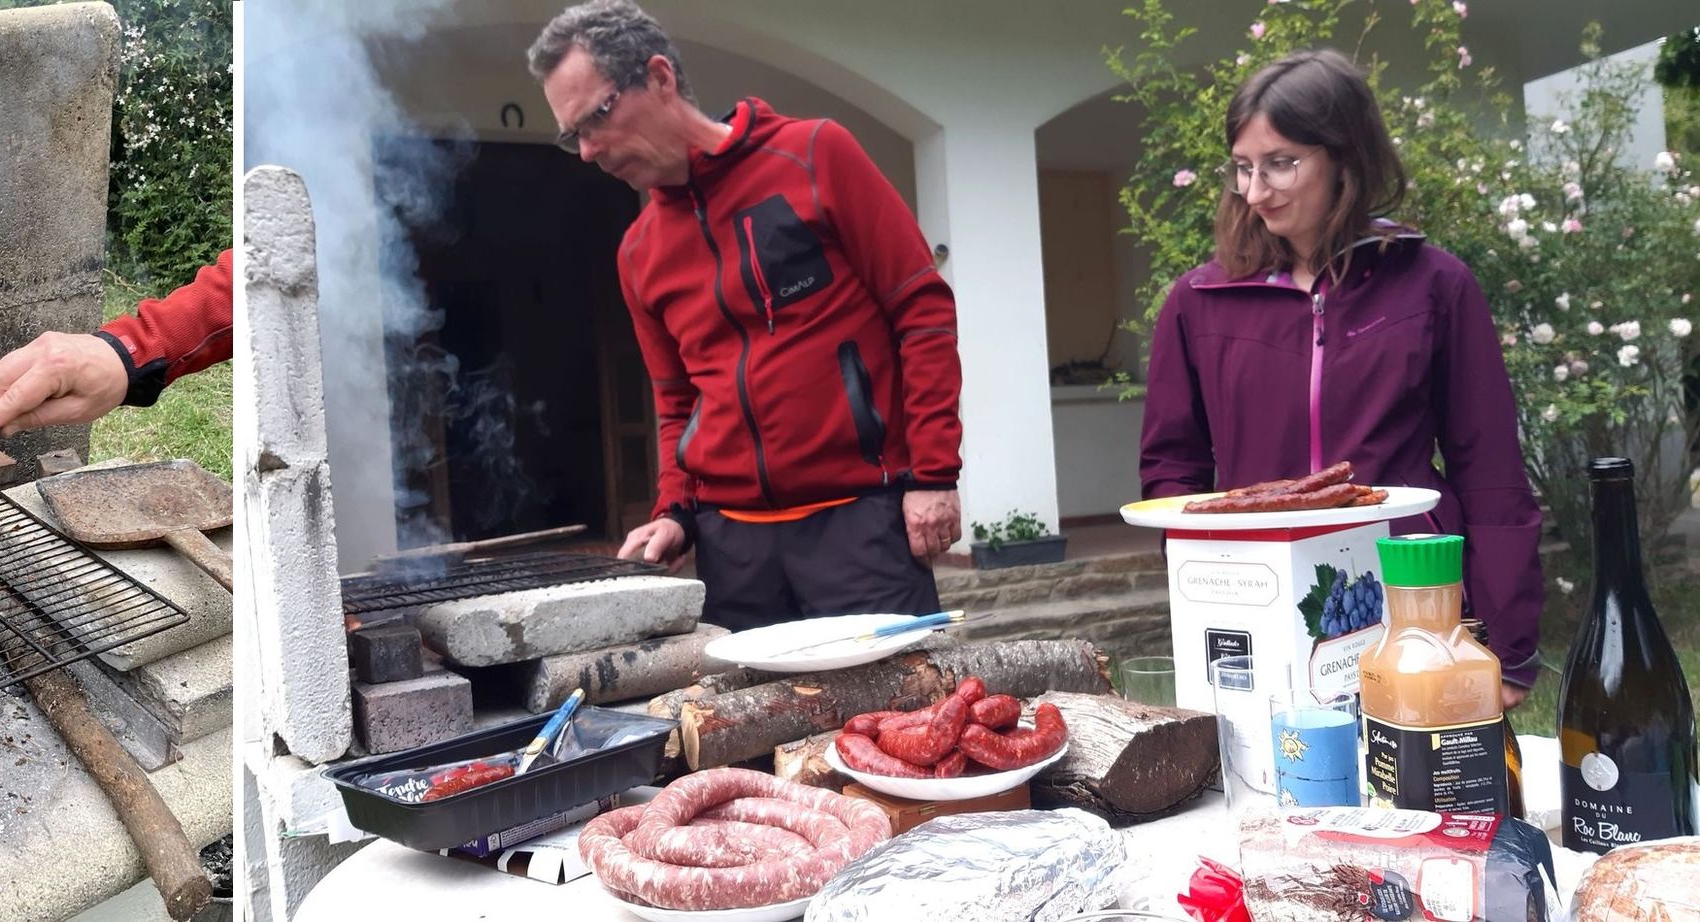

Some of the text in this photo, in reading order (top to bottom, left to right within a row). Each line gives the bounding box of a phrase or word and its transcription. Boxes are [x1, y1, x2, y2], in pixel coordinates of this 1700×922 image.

[1187, 576, 1268, 589] GRENACHE SYRAH
[1344, 671, 1357, 681] PAYS
[1374, 757, 1395, 772] Pomme
[1371, 766, 1396, 784] Mirabelle
[375, 778, 429, 797] Tendre
[1382, 781, 1397, 795] Poire
[1574, 798, 1633, 814] DOMAINE
[1572, 816, 1642, 842] Roc Blanc
